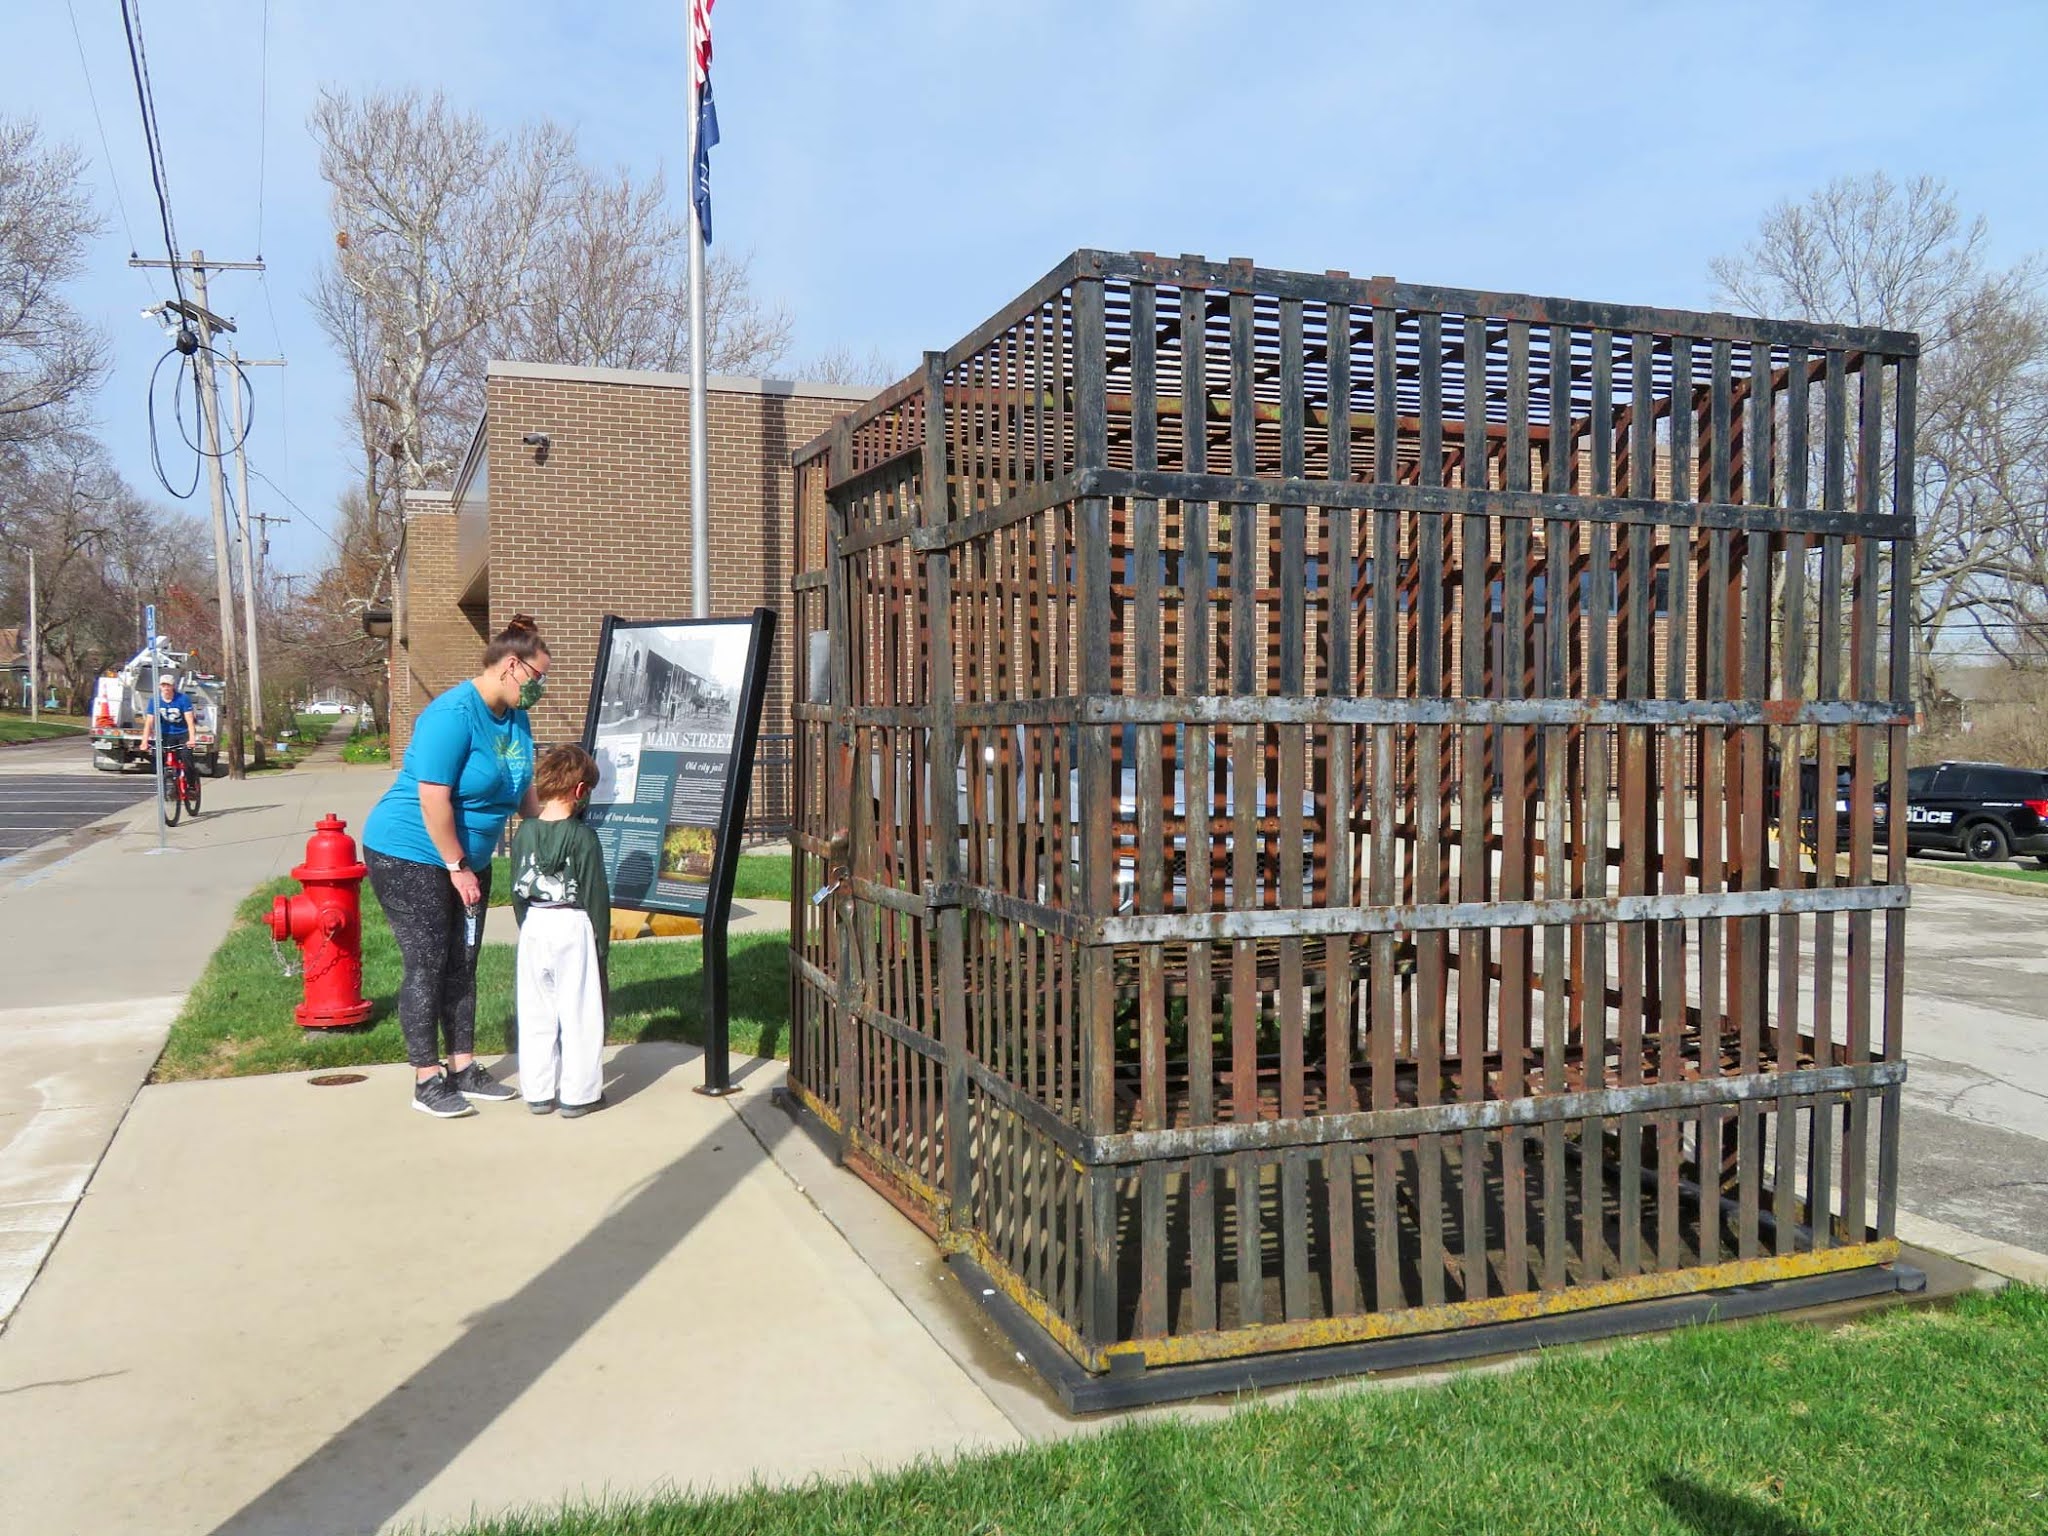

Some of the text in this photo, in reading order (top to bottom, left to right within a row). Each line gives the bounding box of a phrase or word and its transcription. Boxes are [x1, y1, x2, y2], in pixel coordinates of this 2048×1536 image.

[646, 731, 734, 749] MAIN STREET
[685, 761, 724, 774] Old city jail
[604, 812, 613, 824] of
[1906, 811, 1953, 824] LICE
